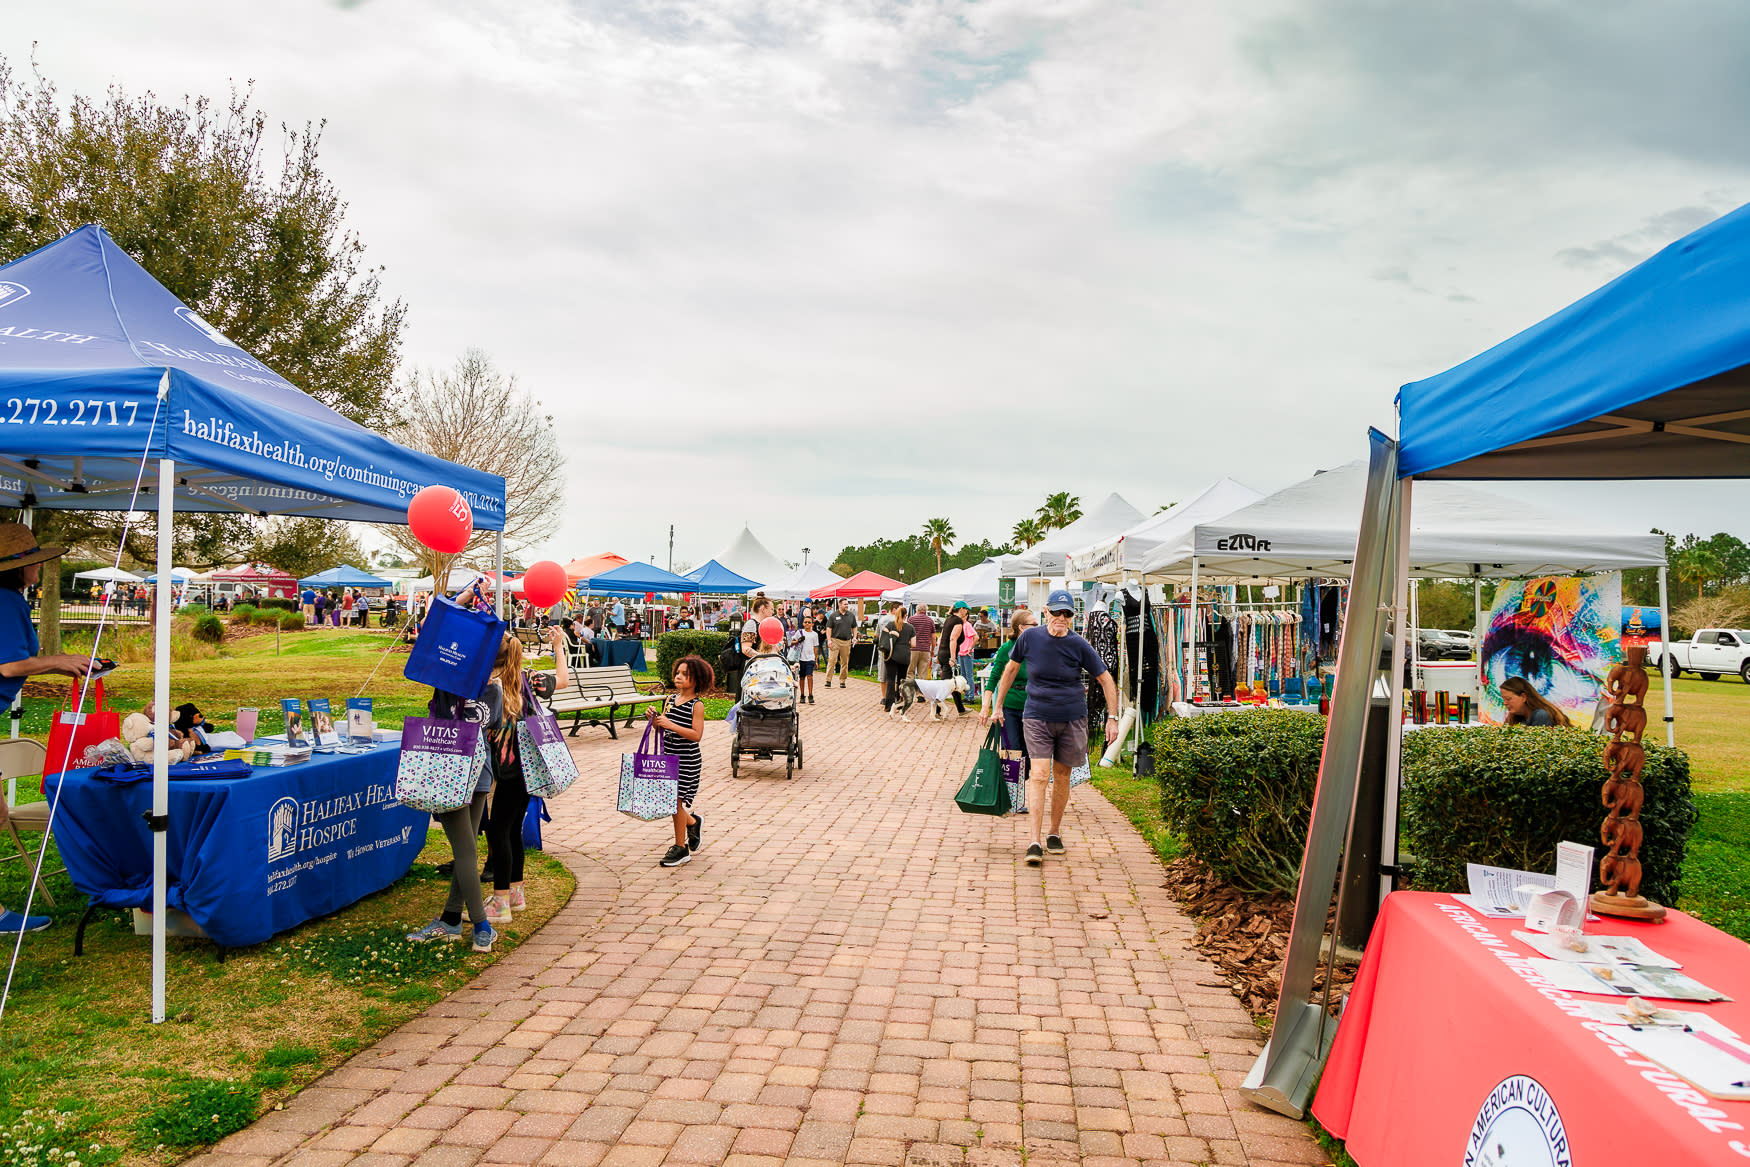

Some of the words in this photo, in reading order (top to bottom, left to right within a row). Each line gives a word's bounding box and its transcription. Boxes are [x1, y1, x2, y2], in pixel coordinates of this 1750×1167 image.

[0, 326, 99, 344] ALTH
[182, 409, 425, 499] halifaxhealth.org/continuingcar
[422, 725, 458, 739] VITAS
[423, 736, 457, 746] Healthcare
[641, 759, 666, 769] VITAS
[301, 791, 364, 826] HALIFAX
[364, 783, 395, 807] HEA
[299, 818, 357, 852] HOSPICE
[1433, 902, 1510, 948] AFRICAN
[1471, 1079, 1524, 1150] AMERICAN
